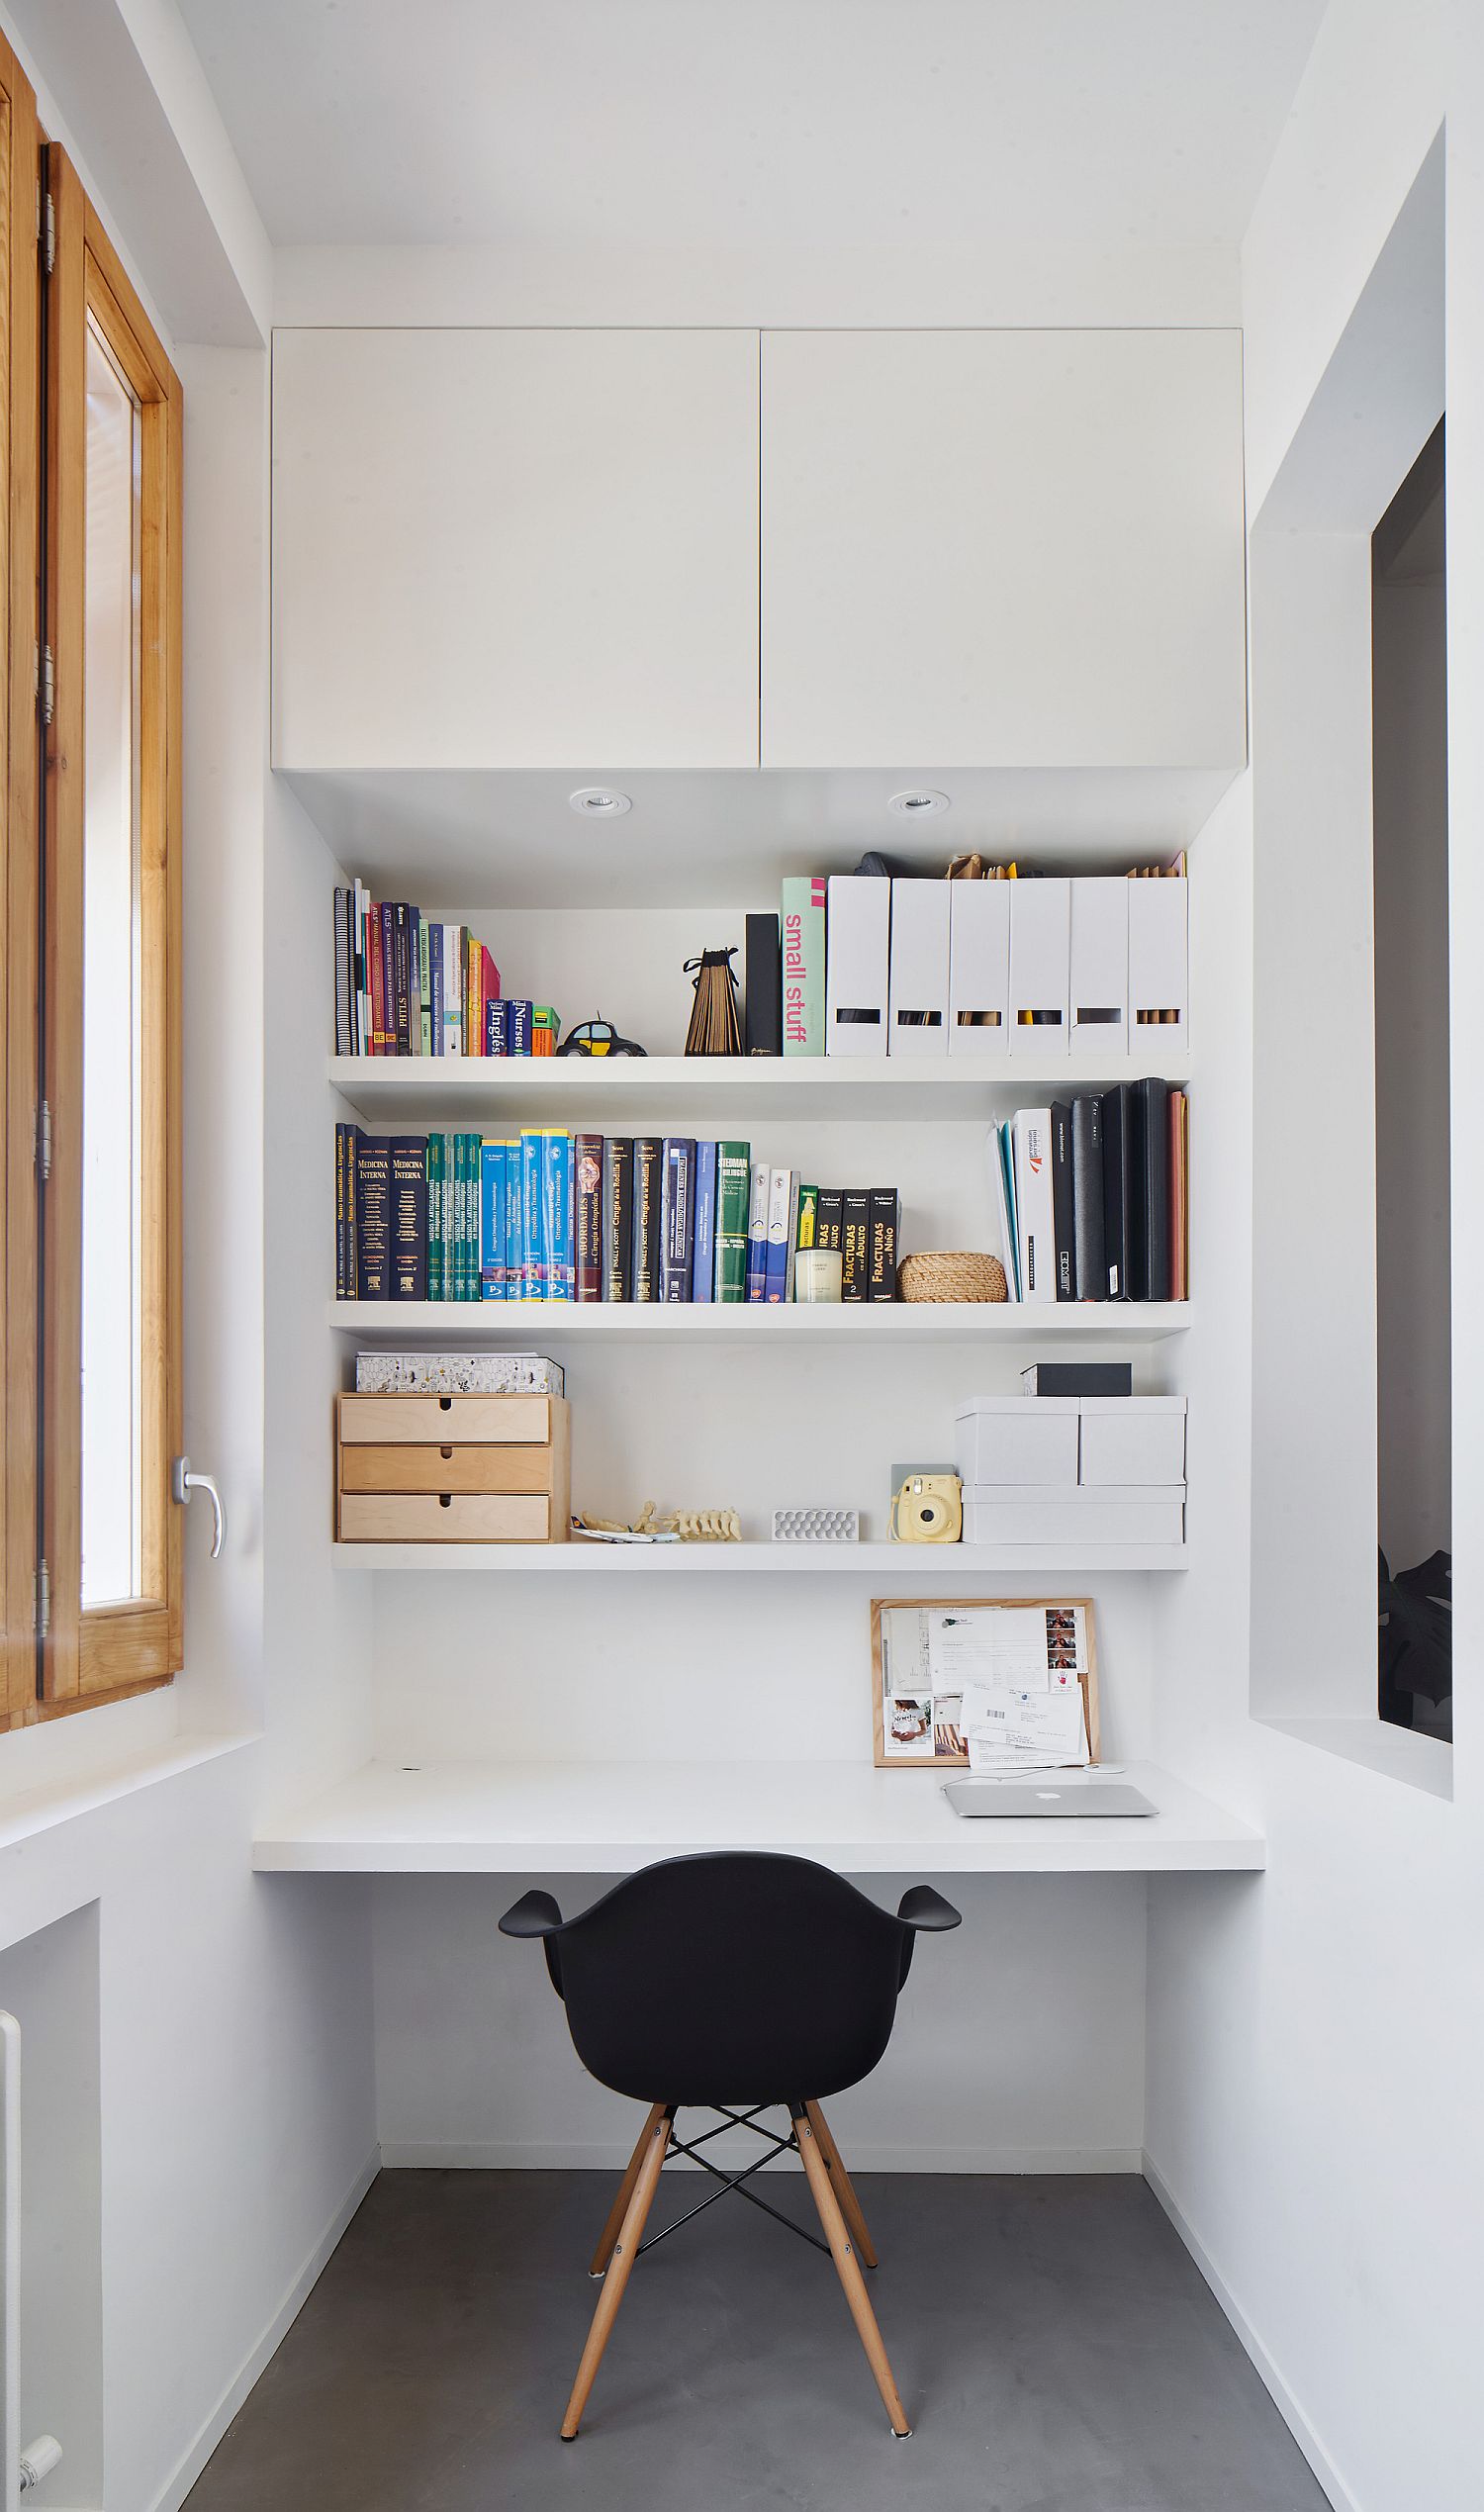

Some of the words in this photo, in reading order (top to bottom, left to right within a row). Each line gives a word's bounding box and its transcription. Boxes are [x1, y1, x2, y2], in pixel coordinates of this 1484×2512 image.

[786, 914, 807, 980] small
[399, 997, 408, 1027] PHTLS
[514, 1007, 526, 1048] Nurses
[786, 986, 807, 1044] stuff
[489, 1011, 505, 1053] Inglés
[360, 1170, 387, 1179] INTERNA
[395, 1169, 420, 1179] INTERNA
[718, 1159, 748, 1168] STEDMAN
[612, 1200, 621, 1225] Cirugía
[641, 1200, 650, 1225] Cirugía
[843, 1224, 856, 1284] FRACTURAS
[856, 1225, 866, 1257] ADULTO
[872, 1222, 883, 1283] FRACTURAS
[884, 1228, 893, 1252] NIÑO
